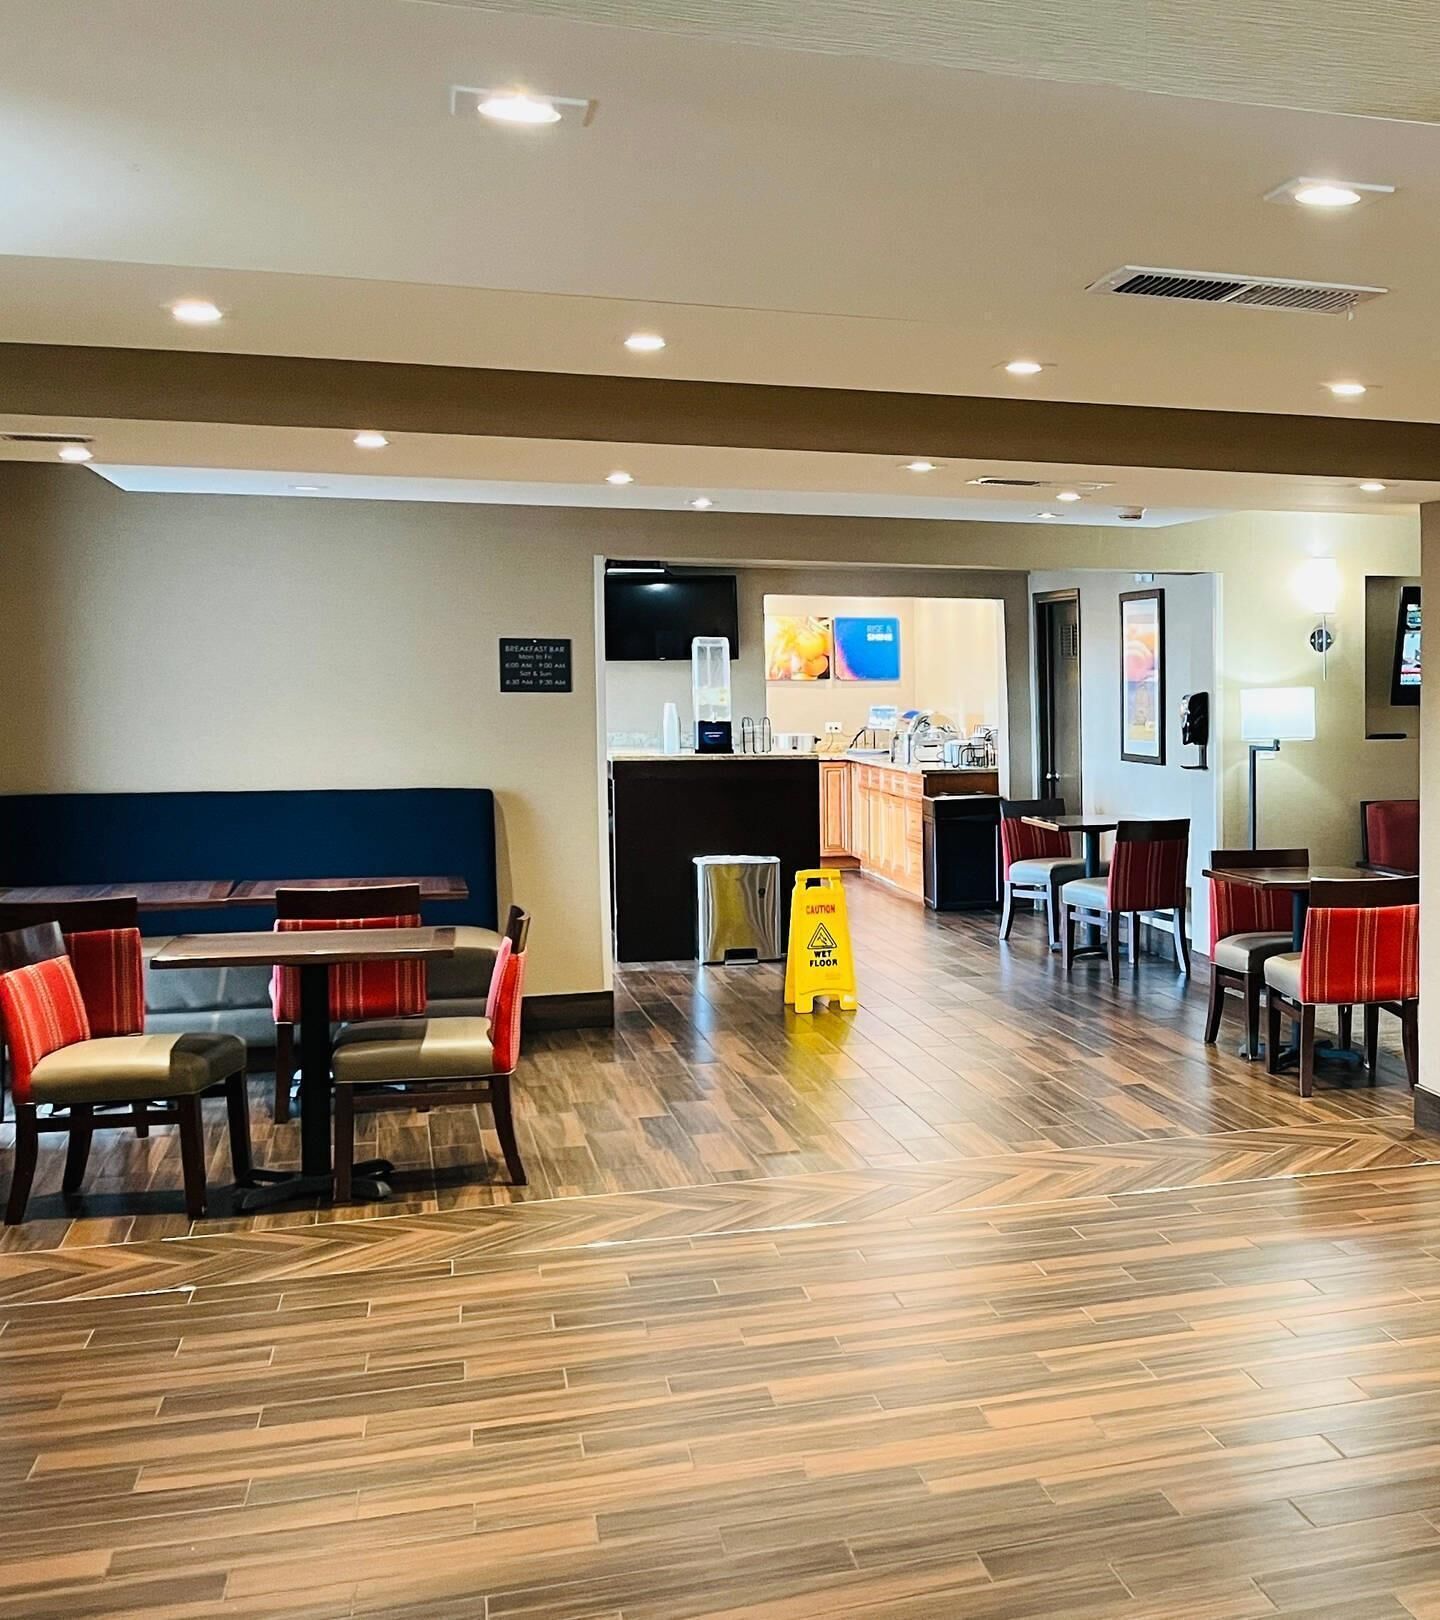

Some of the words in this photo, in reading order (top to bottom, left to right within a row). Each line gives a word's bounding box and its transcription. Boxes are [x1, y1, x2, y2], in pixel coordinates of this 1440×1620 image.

[505, 645, 547, 653] BREAKFAST
[806, 904, 836, 915] CAUTION
[814, 950, 832, 958] WET
[809, 959, 838, 968] FLOOR
